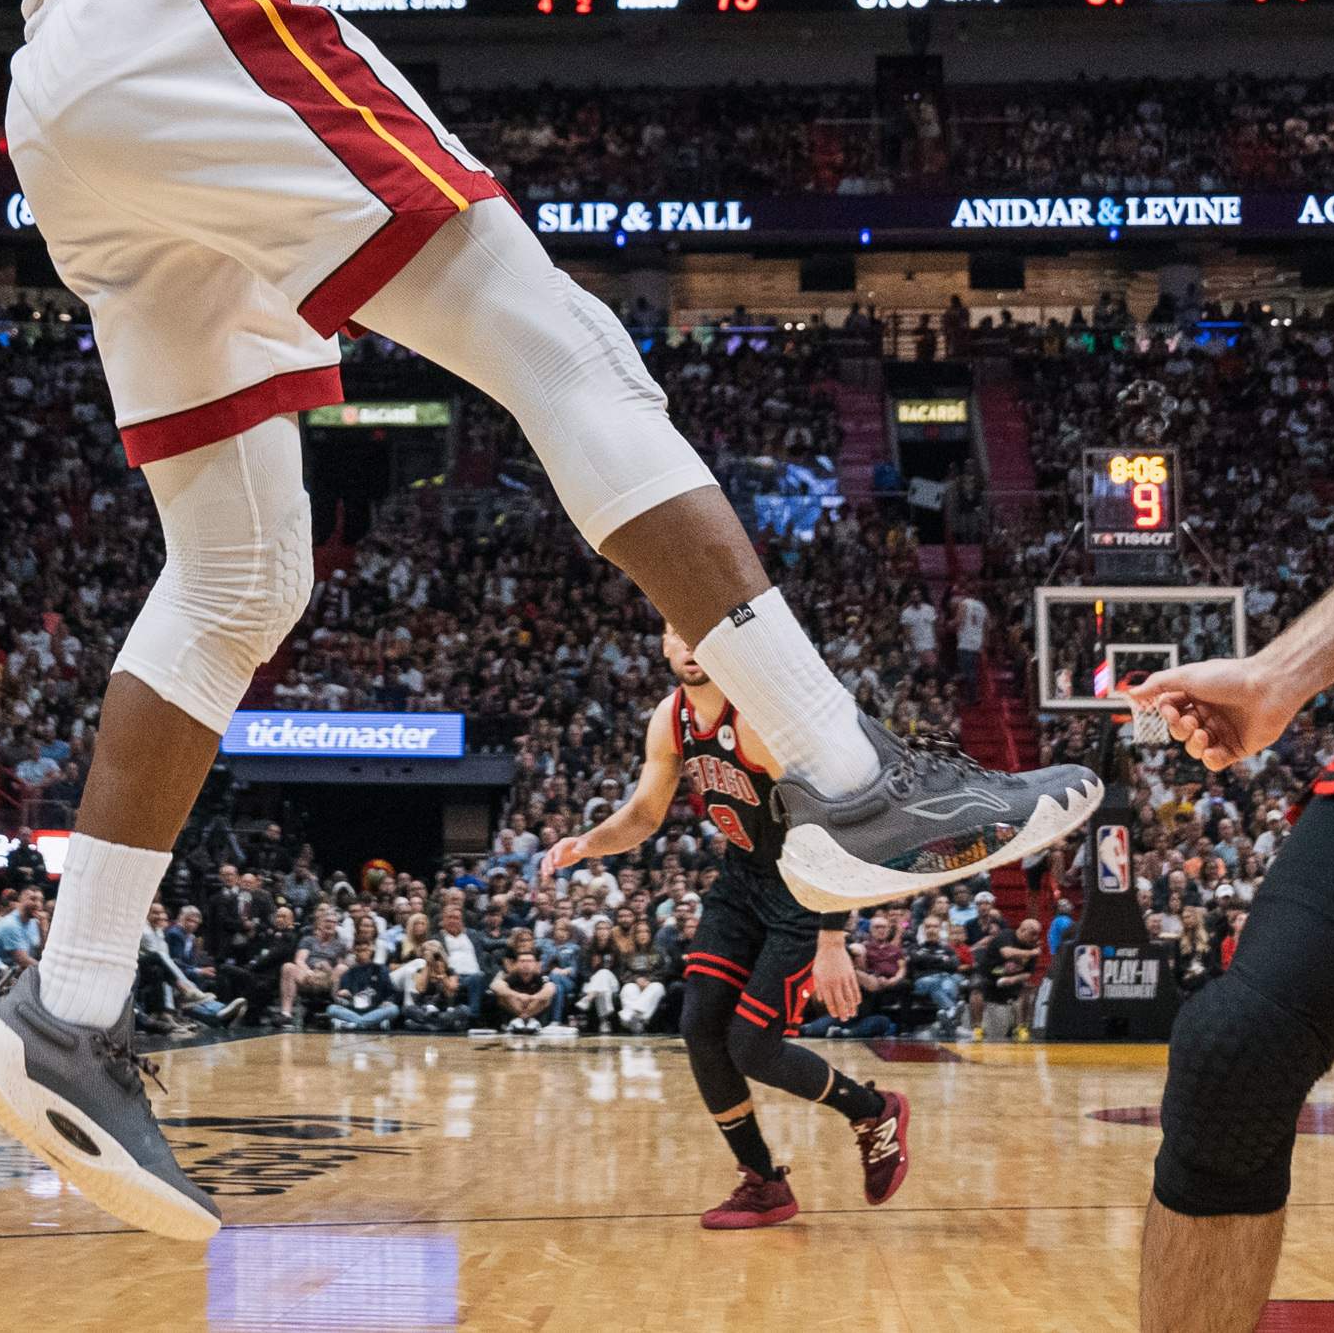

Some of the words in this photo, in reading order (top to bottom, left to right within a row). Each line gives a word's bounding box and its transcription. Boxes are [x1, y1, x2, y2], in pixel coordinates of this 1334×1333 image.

[538, 201, 619, 233] SLIP
[620, 201, 654, 233] &
[658, 201, 753, 232] FALL
[951, 197, 1094, 228] ANIDJAR
[1094, 196, 1124, 224] &
[1125, 196, 1242, 227] LEVINE
[1109, 454, 1168, 484] 8:06
[1131, 483, 1162, 528] 9
[1114, 531, 1175, 546] TISSOT
[247, 719, 438, 750] ticketmaster
[1103, 958, 1160, 984] PLAY-IN
